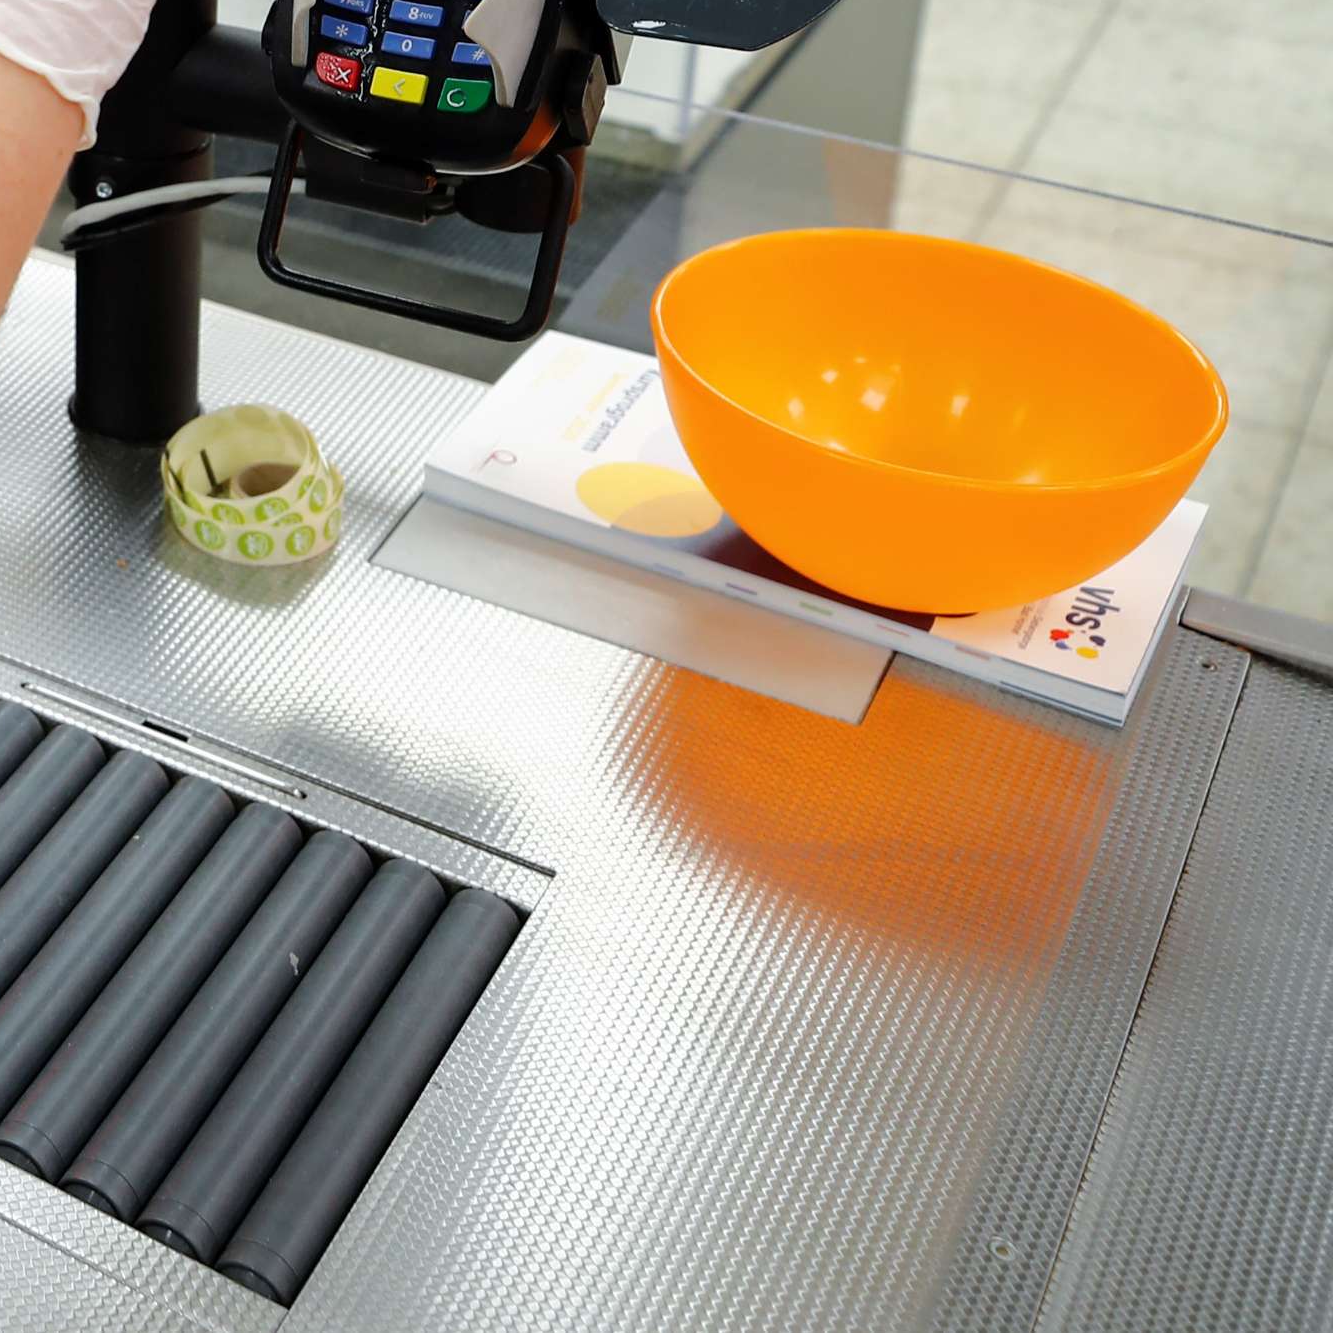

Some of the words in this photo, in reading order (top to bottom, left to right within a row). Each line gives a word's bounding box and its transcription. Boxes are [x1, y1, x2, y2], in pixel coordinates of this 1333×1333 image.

[408, 6, 420, 20] 8
[401, 39, 413, 53] 0
[1065, 586, 1121, 631] vhs
